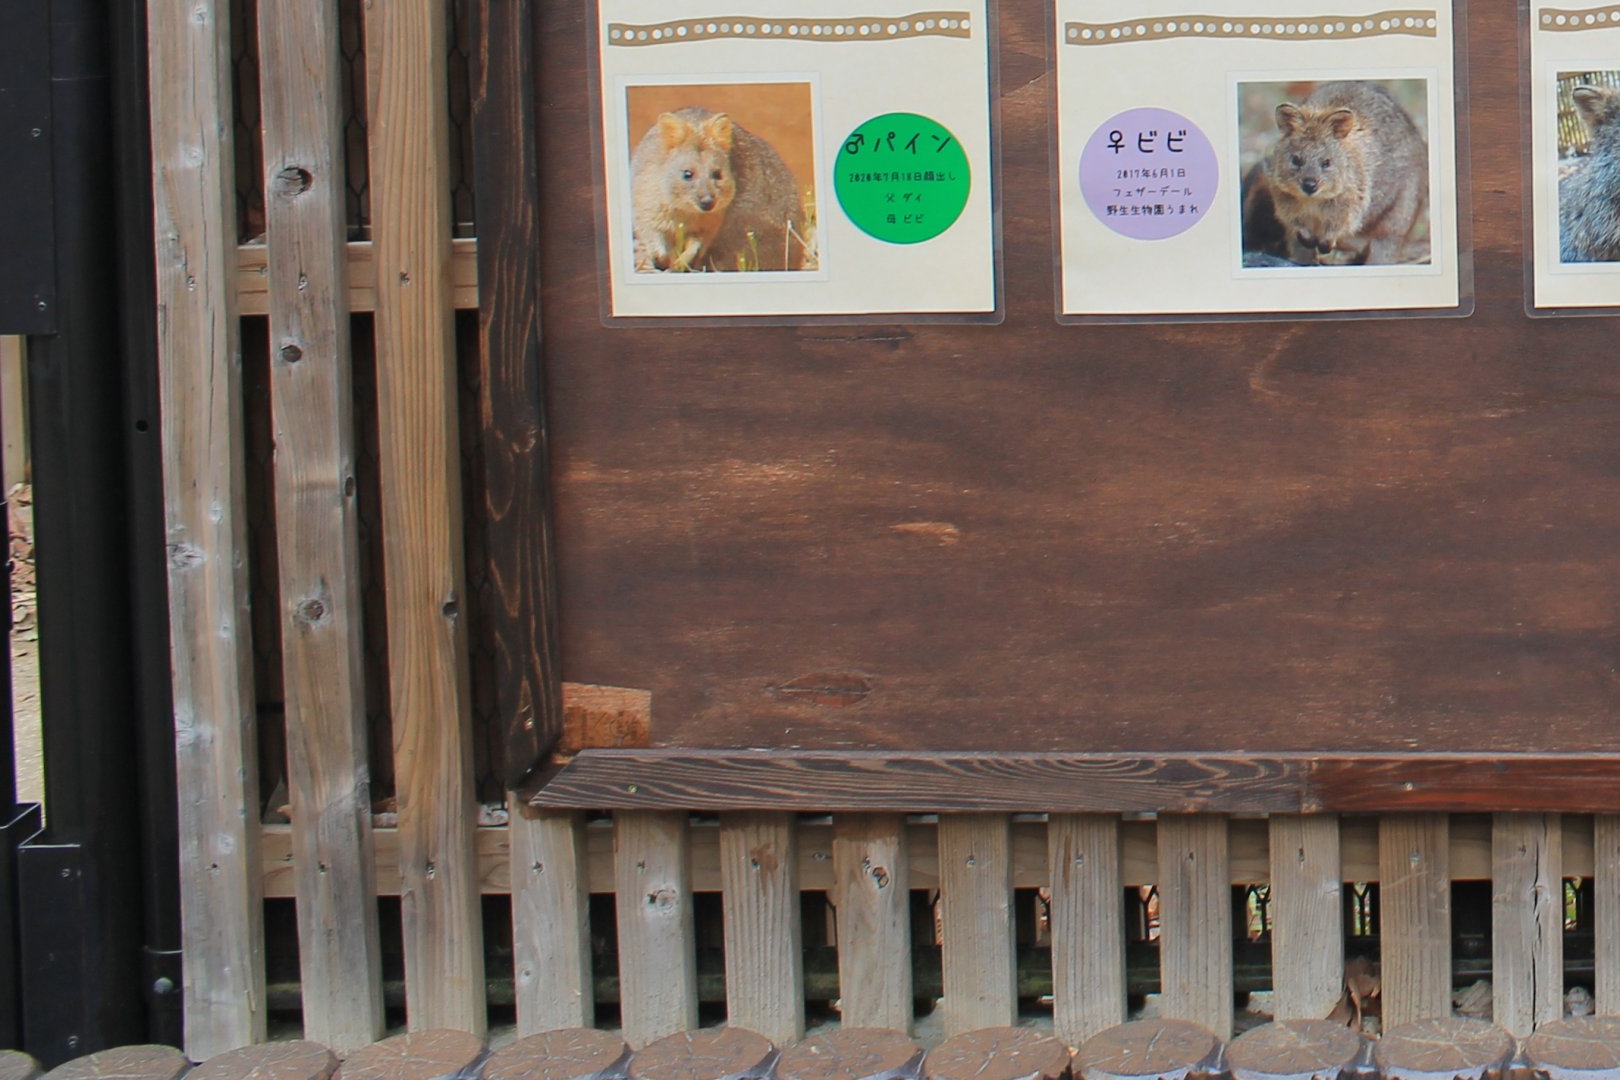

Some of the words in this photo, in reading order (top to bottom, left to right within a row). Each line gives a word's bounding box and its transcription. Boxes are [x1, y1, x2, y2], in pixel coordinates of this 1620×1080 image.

[873, 131, 951, 155] パイン
[1137, 129, 1187, 153] ビビ
[1113, 185, 1192, 197] フェザーデール
[1106, 204, 1199, 216] 野生生物園うまれ
